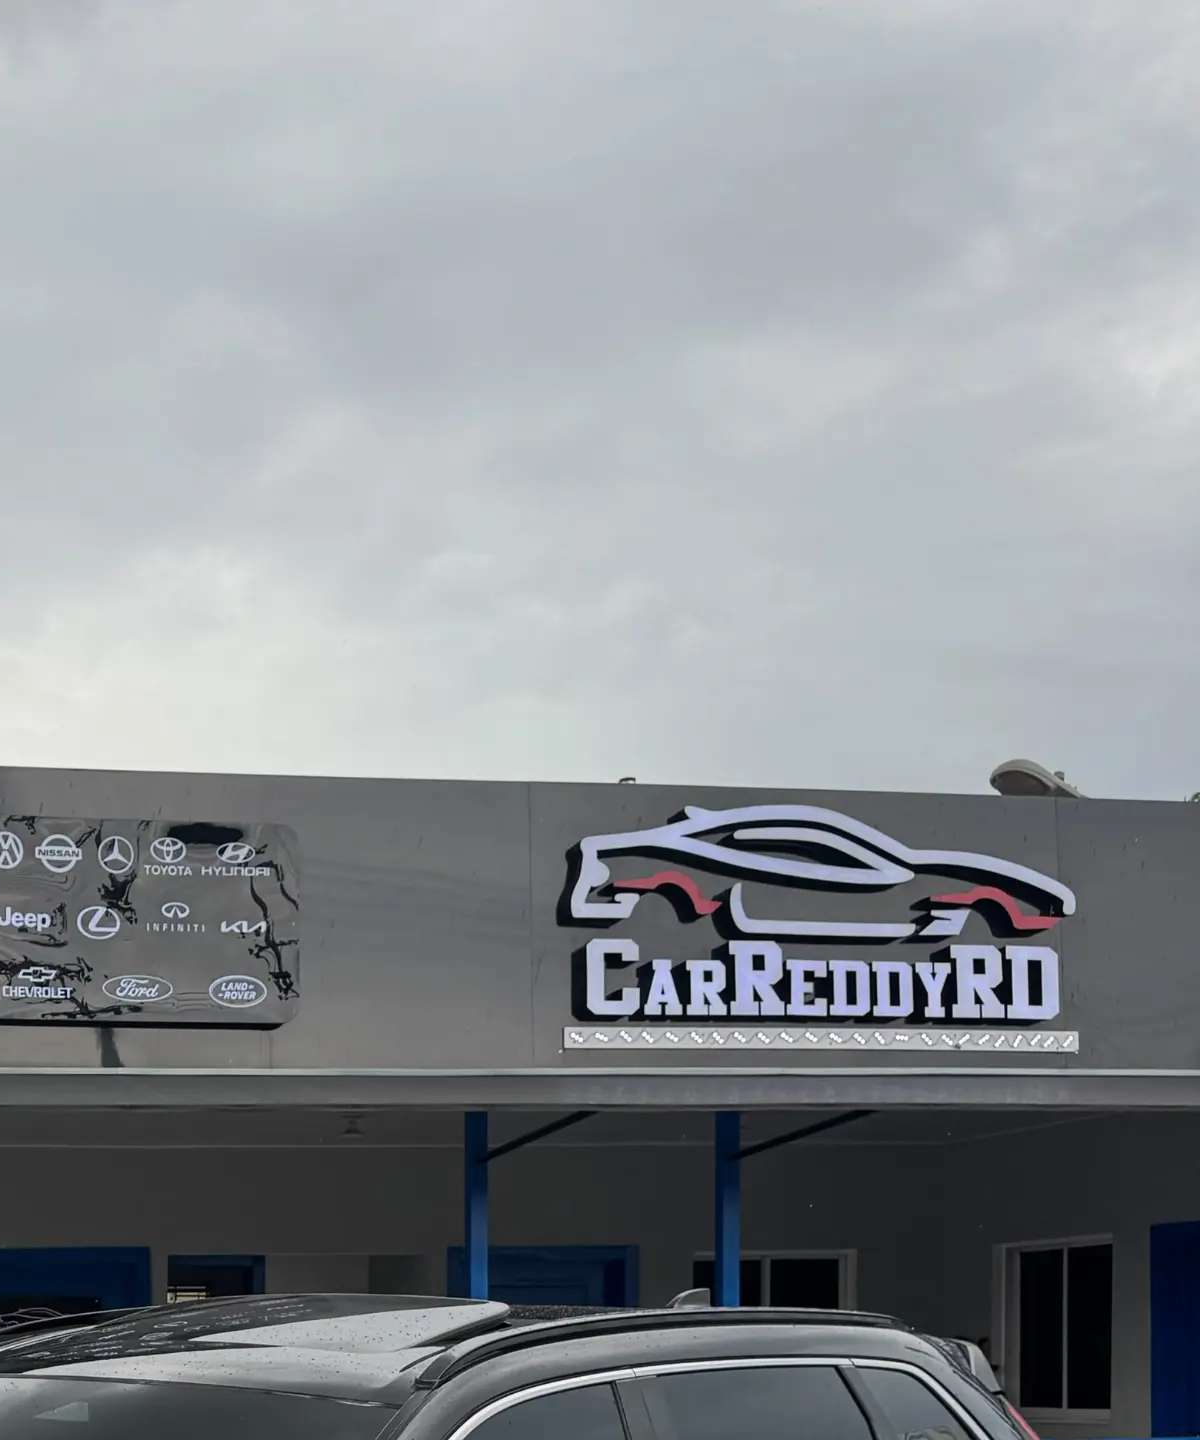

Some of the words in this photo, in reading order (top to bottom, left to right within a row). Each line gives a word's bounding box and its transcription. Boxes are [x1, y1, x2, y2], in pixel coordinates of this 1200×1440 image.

[37, 848, 80, 858] NISSAN
[144, 864, 193, 876] TOYOTA
[201, 866, 271, 877] HYUNDAI
[146, 922, 206, 933] INFINITI
[2, 985, 74, 999] CHEVROLET
[115, 978, 160, 998] Ford
